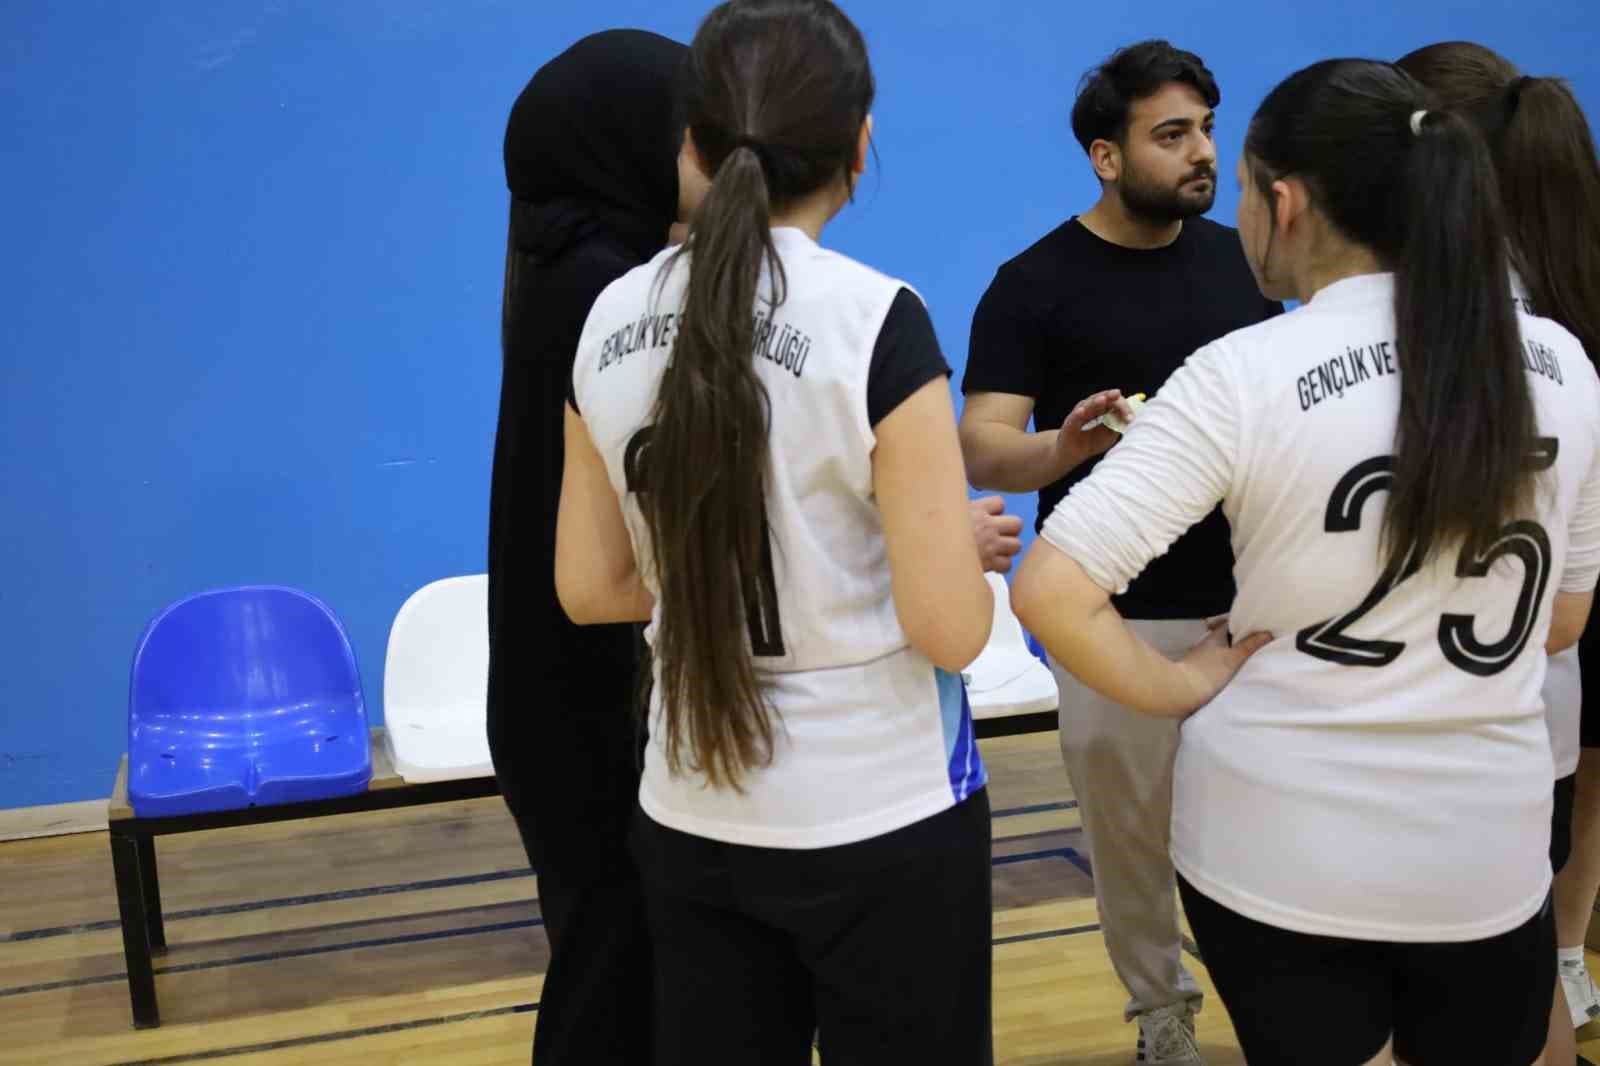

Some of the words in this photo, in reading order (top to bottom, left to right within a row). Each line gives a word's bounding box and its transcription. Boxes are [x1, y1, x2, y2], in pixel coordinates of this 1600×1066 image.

[651, 313, 675, 348] VE
[752, 310, 811, 378] ÜRLÜĞÜ
[1297, 346, 1371, 411] GENÇLİK
[1369, 342, 1396, 376] VE
[1296, 437, 1559, 677] 25
